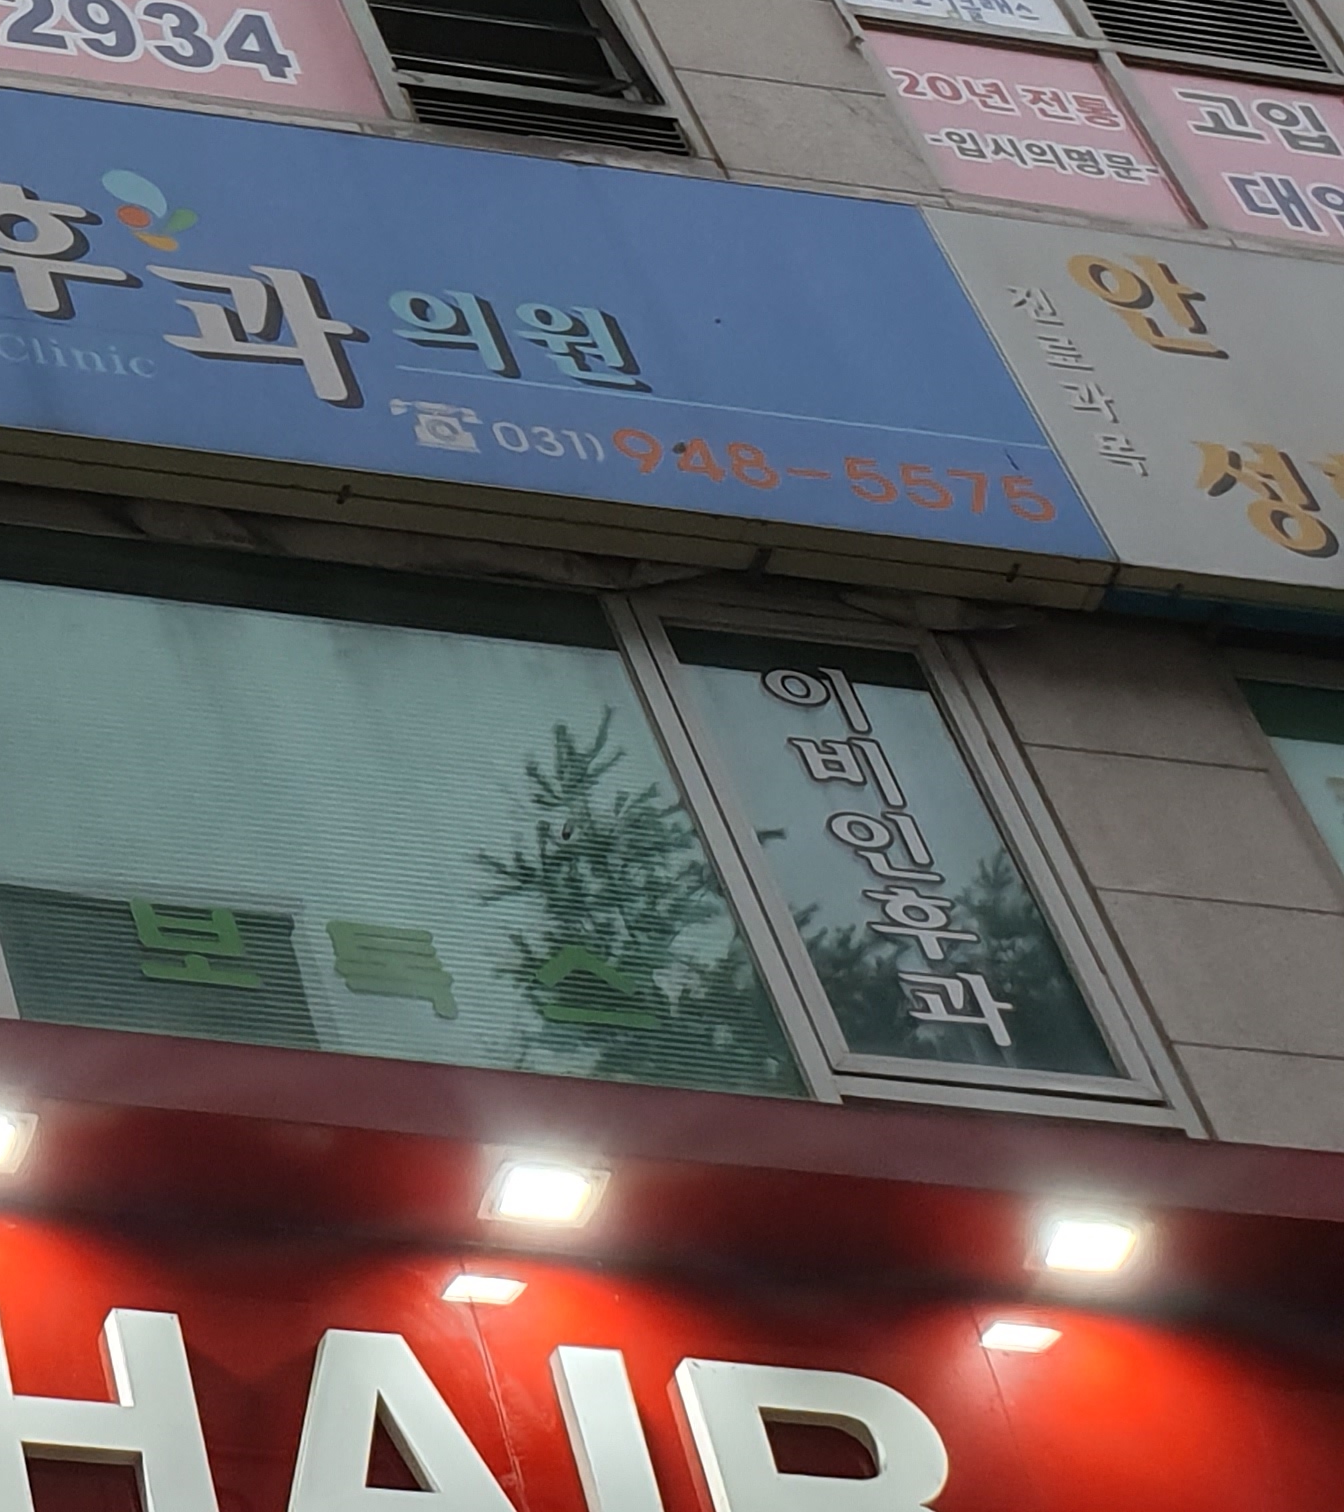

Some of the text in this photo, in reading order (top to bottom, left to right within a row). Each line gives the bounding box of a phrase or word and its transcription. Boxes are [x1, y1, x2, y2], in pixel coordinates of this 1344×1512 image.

[889, 67, 1128, 131] 20년 전통
[1174, 88, 1344, 159] 고입
[389, 287, 654, 394] 의원
[760, 666, 1014, 1048] 이비인후과
[130, 895, 664, 1031] 보톡스
